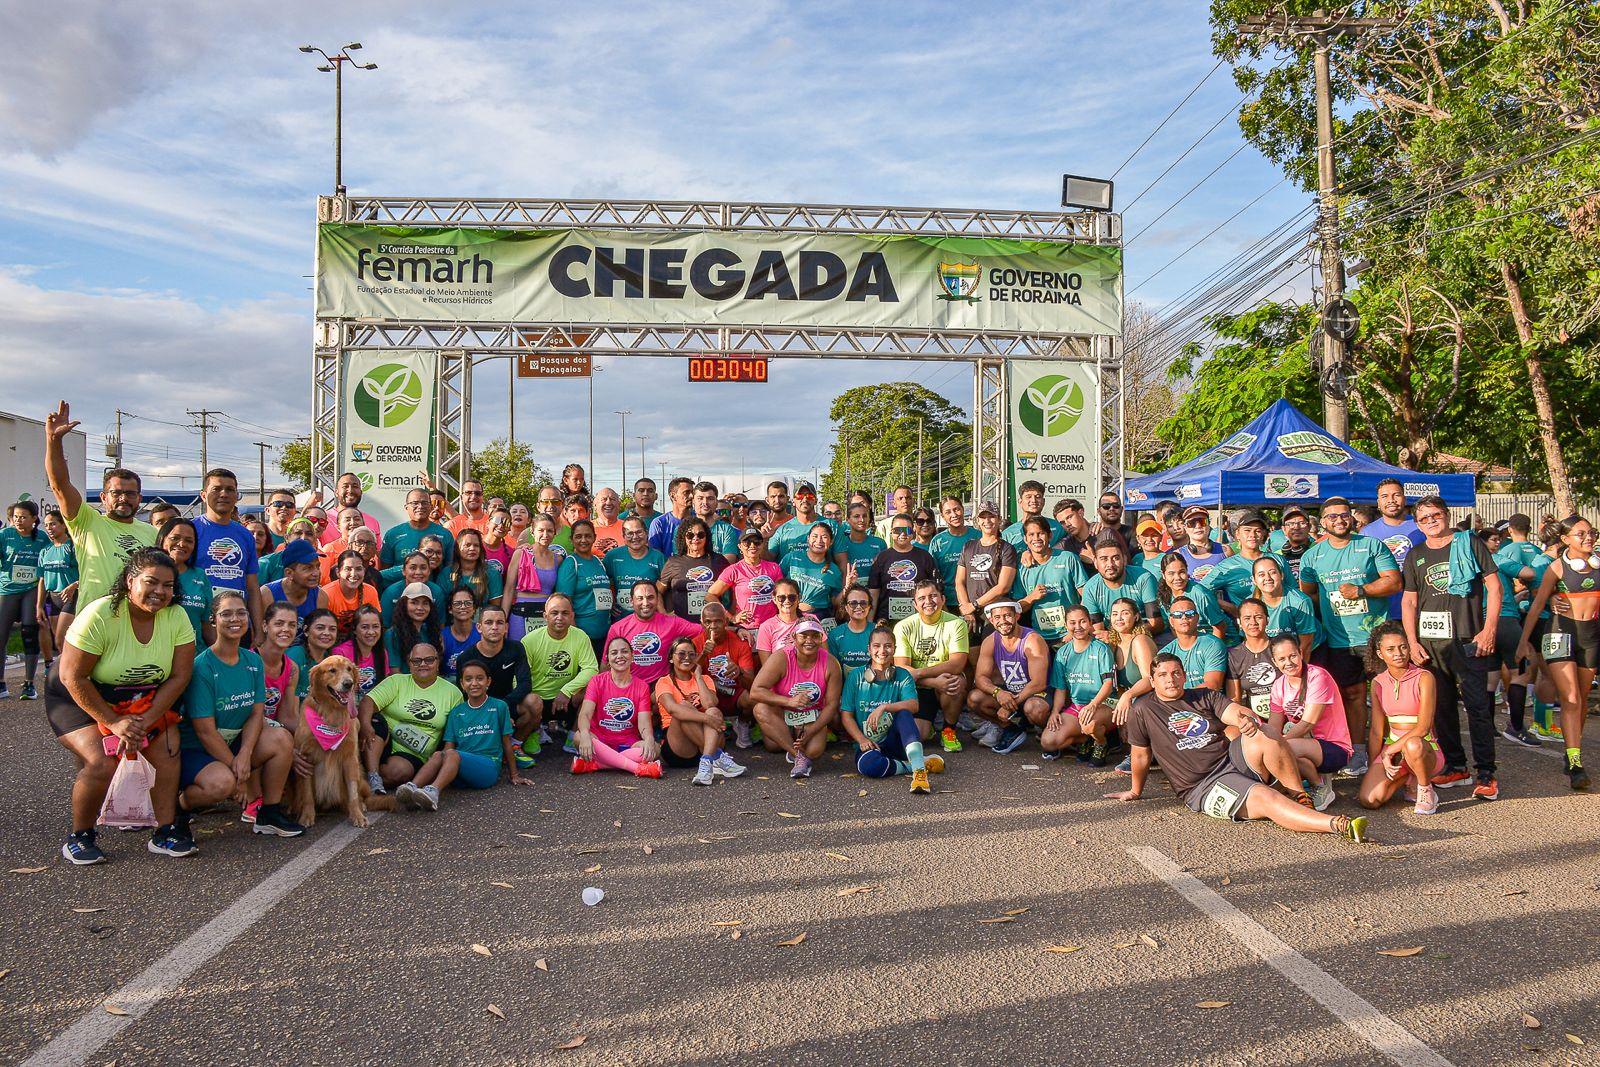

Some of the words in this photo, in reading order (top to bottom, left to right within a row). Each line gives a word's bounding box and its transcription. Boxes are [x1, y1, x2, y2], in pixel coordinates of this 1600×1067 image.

[388, 245, 414, 254] Corrida
[414, 246, 444, 255] Pedestre
[445, 246, 455, 255] da
[358, 248, 494, 284] femarh
[548, 244, 899, 302] CHEGADA
[989, 268, 1082, 290] GOVERNO
[357, 286, 392, 296] Fundação
[989, 288, 1008, 302] DE
[1012, 288, 1082, 306] RORAIMA
[376, 446, 422, 455] GOVERNO
[1041, 454, 1084, 464] GOVERNO
[1335, 600, 1359, 608] 0422
[1422, 621, 1444, 631] 0592
[231, 692, 251, 702] Corrida
[395, 729, 420, 748] 0346
[1212, 794, 1225, 816] 0179
